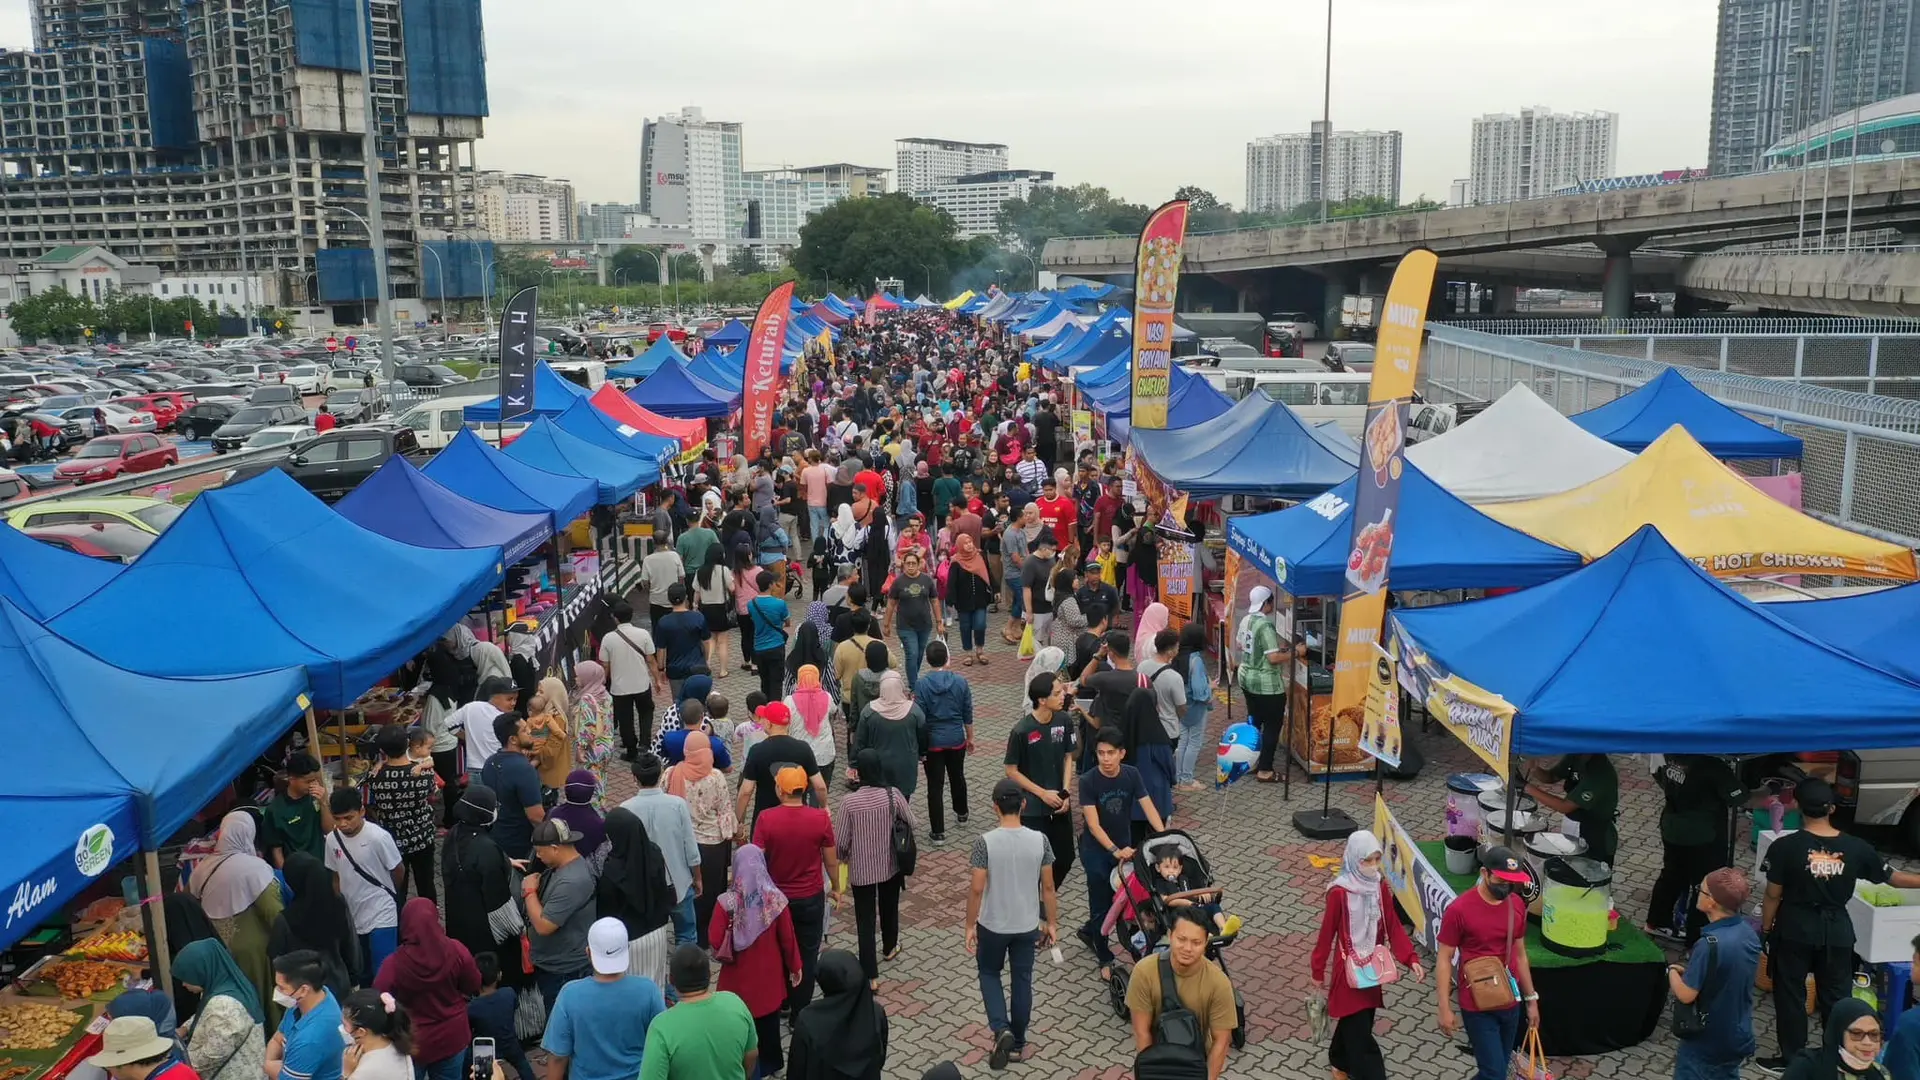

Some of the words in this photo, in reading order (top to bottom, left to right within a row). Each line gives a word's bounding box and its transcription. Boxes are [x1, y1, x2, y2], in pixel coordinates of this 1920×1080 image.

[1387, 302, 1419, 329] MUIZ
[1145, 322, 1165, 344] NASI
[752, 313, 782, 395] Keturah
[751, 400, 769, 442] Sate
[1714, 552, 1754, 570] HOT
[1760, 552, 1846, 569] CHICKEN
[1346, 627, 1378, 644] MUIZ
[402, 779, 428, 789] 9168
[1666, 768, 1686, 785] CREW
[76, 849, 88, 867] go
[83, 843, 111, 872] GREEN
[1810, 863, 1845, 875] CREW
[6, 877, 57, 929] Alam
